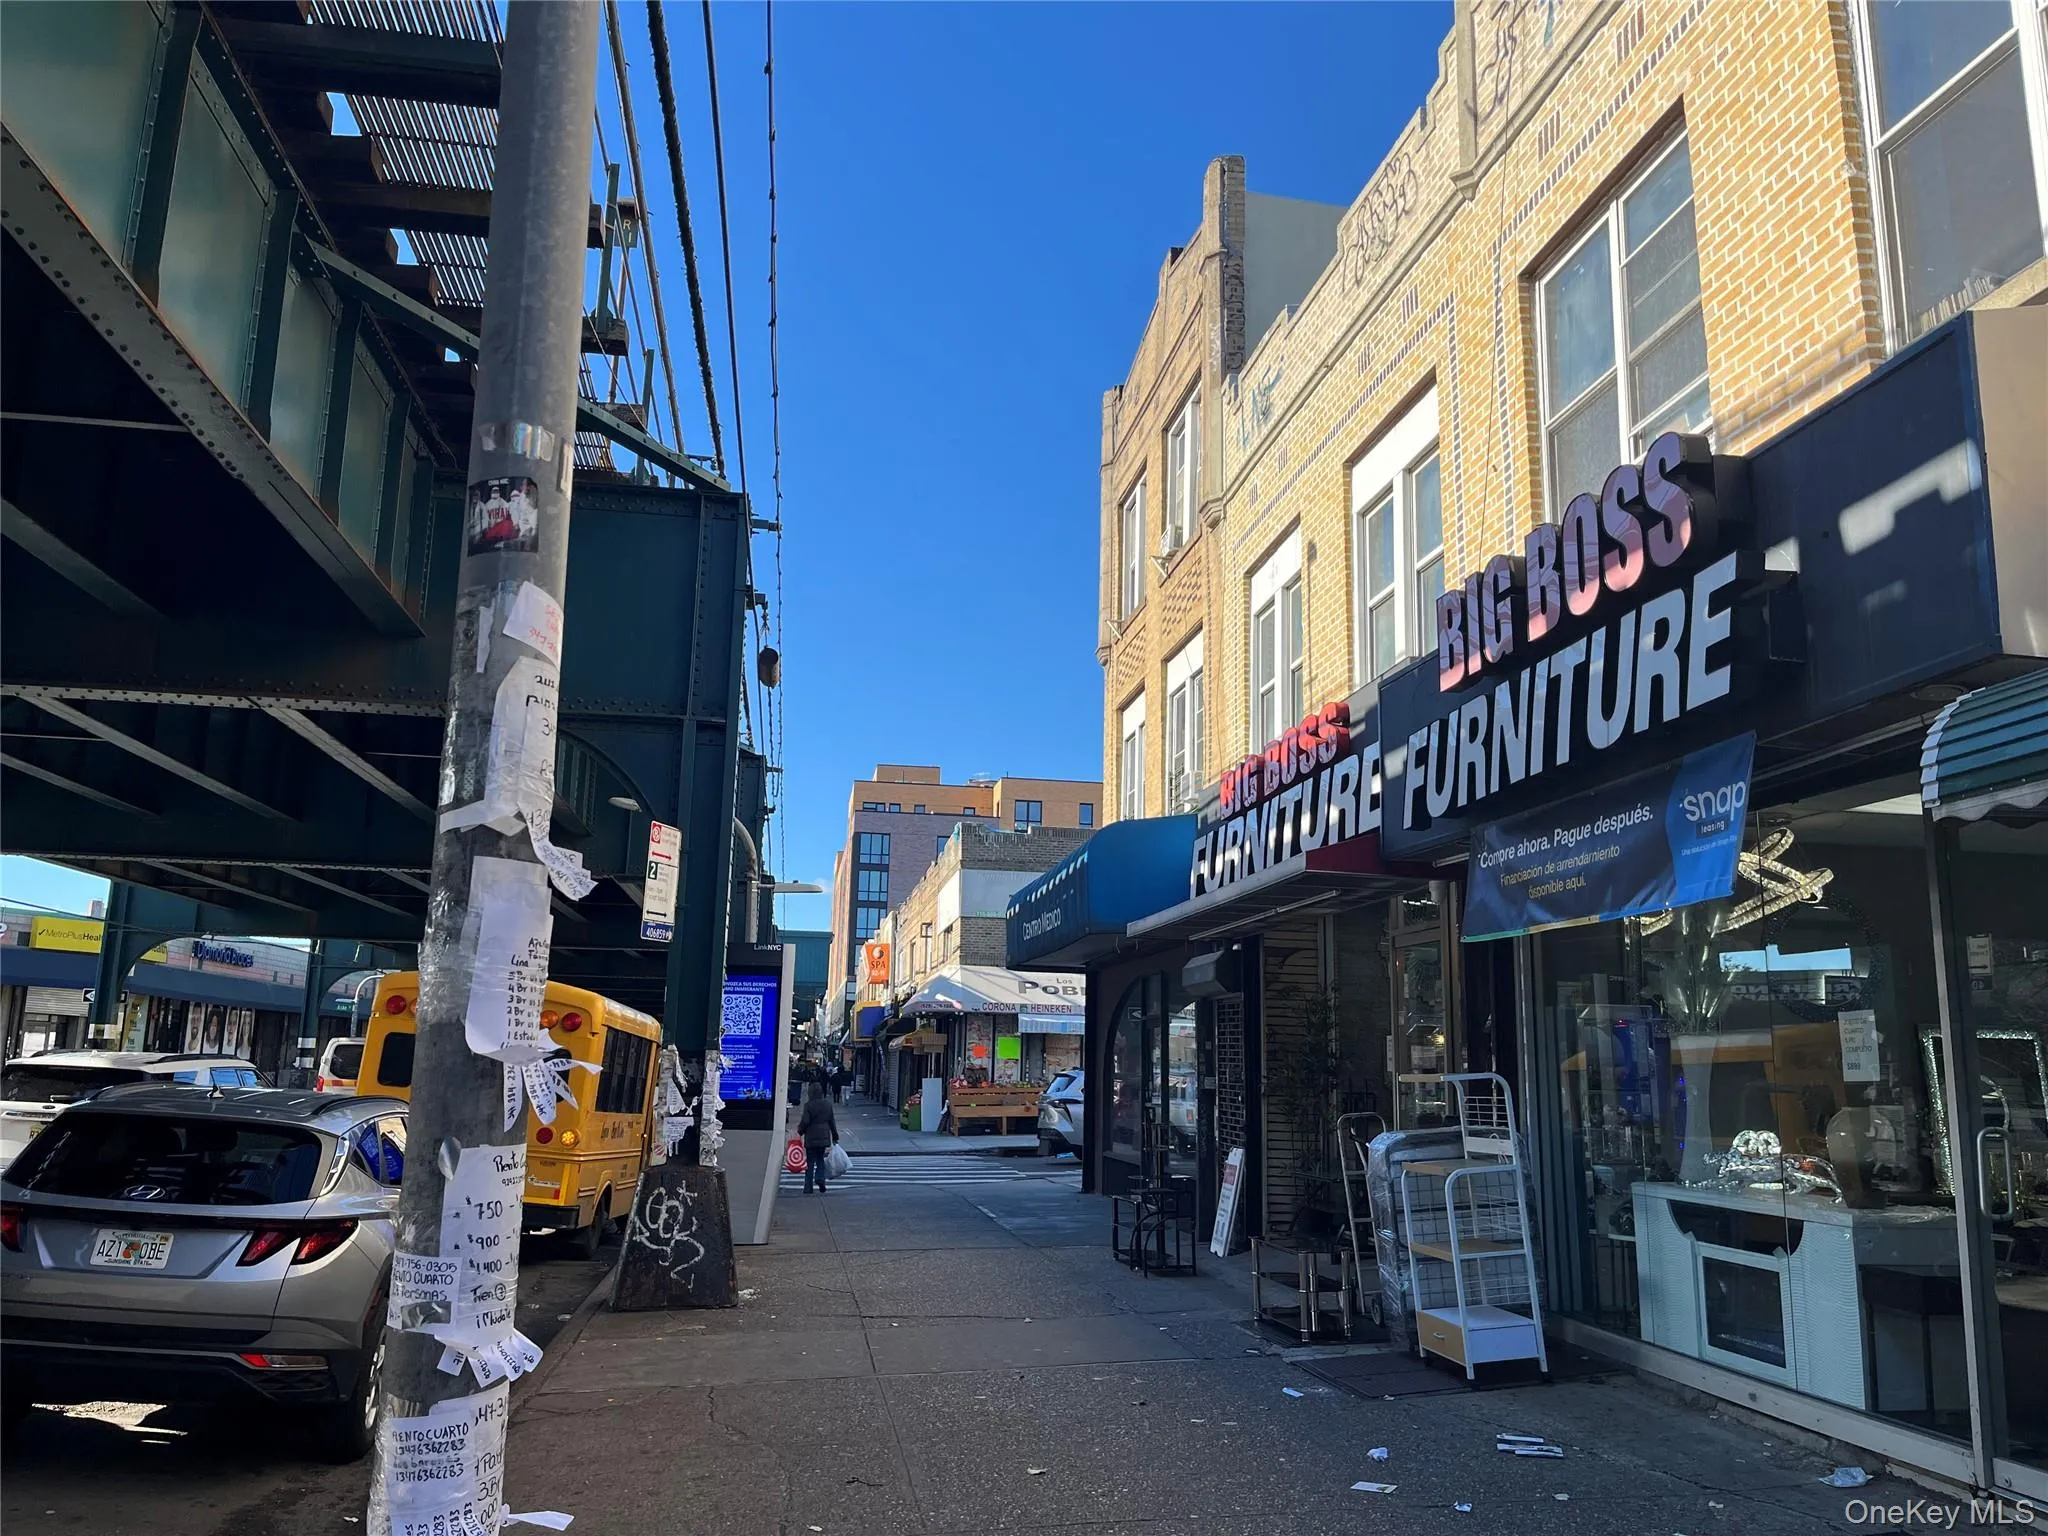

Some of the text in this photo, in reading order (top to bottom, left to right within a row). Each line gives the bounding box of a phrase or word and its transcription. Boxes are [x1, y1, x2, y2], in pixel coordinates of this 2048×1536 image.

[1437, 431, 1700, 692] BIG BOSS
[1402, 551, 1738, 831] FURNITURE
[1220, 702, 1343, 820] BIG BOSS
[1683, 781, 1746, 822] snap
[1189, 741, 1381, 900] FURNITURE
[1701, 820, 1725, 834] leasing
[1479, 802, 1653, 869] Compre ahora. Pague después.
[649, 862, 657, 879] 2
[1500, 843, 1620, 887] Financiación de arrendamiento
[1528, 871, 1587, 899] disponible aquí.
[1022, 907, 1062, 941] CENTRO MEDICO
[45, 928, 102, 942] MetroPlusHeal
[753, 943, 782, 951] LinkNYC
[870, 960, 886, 969] SPA
[1056, 977, 1073, 985] Los
[508, 995, 515, 1003] 3
[982, 1002, 1072, 1013] CORONA HEINEKEN
[507, 1006, 513, 1015] 2
[493, 1151, 518, 1172] Rento
[414, 1271, 454, 1286] CUARTO
